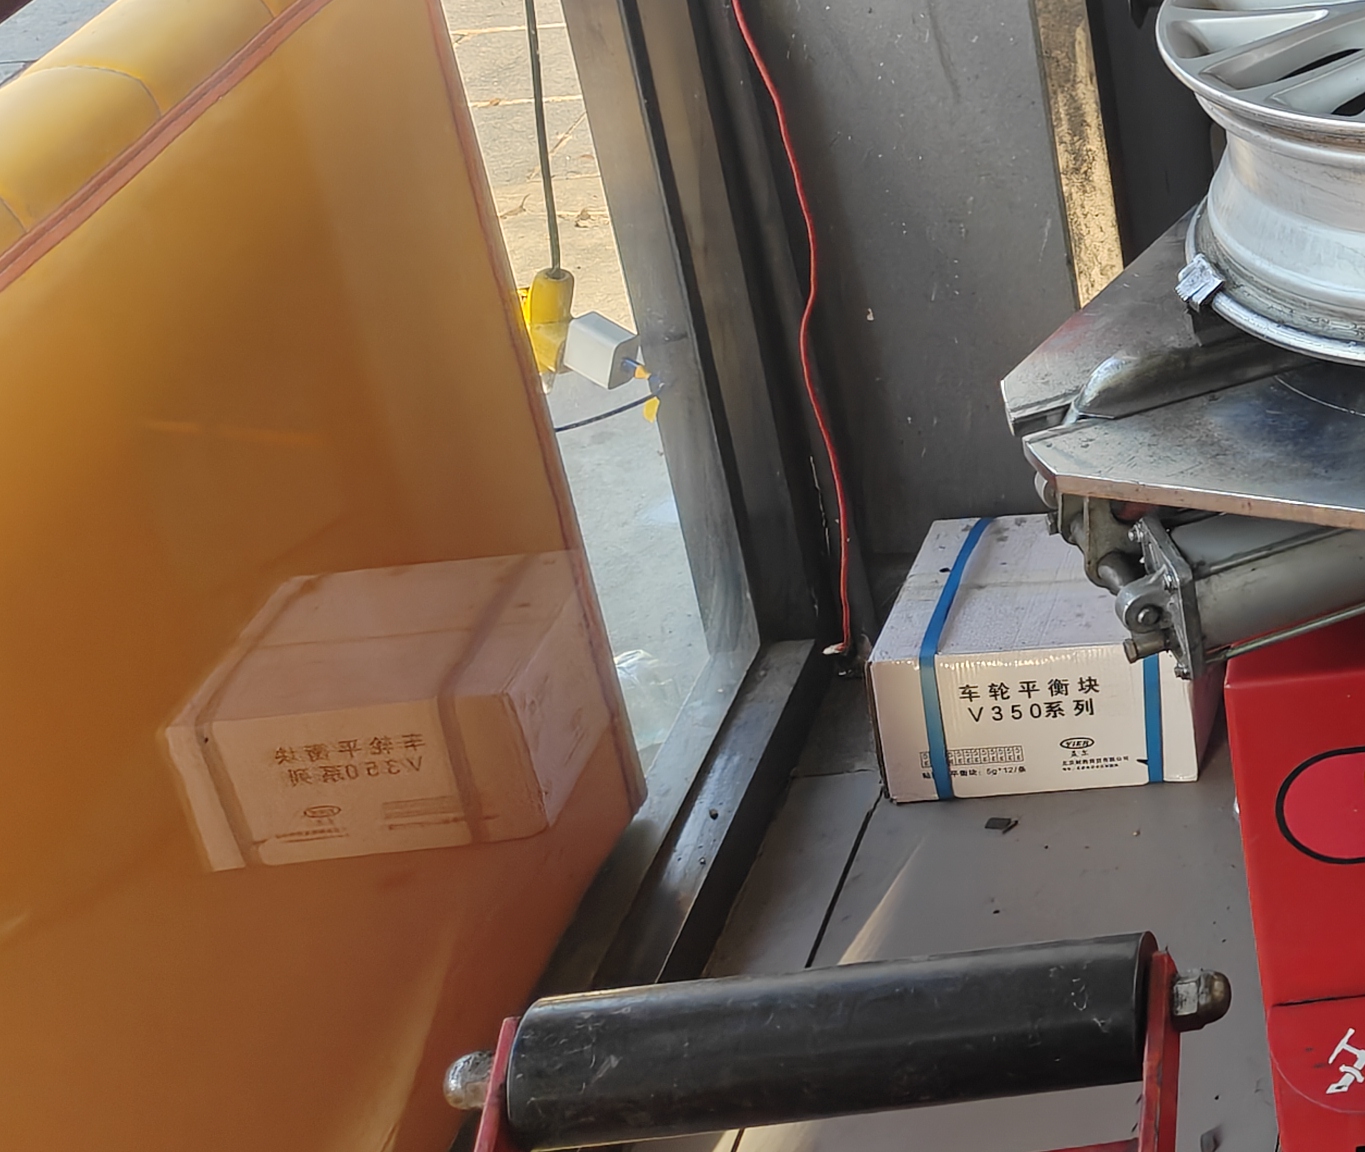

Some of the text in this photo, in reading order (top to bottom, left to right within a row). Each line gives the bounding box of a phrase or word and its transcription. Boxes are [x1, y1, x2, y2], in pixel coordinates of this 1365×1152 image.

[959, 677, 1101, 703] 车轮平衡块
[967, 698, 1095, 723] V350系列
